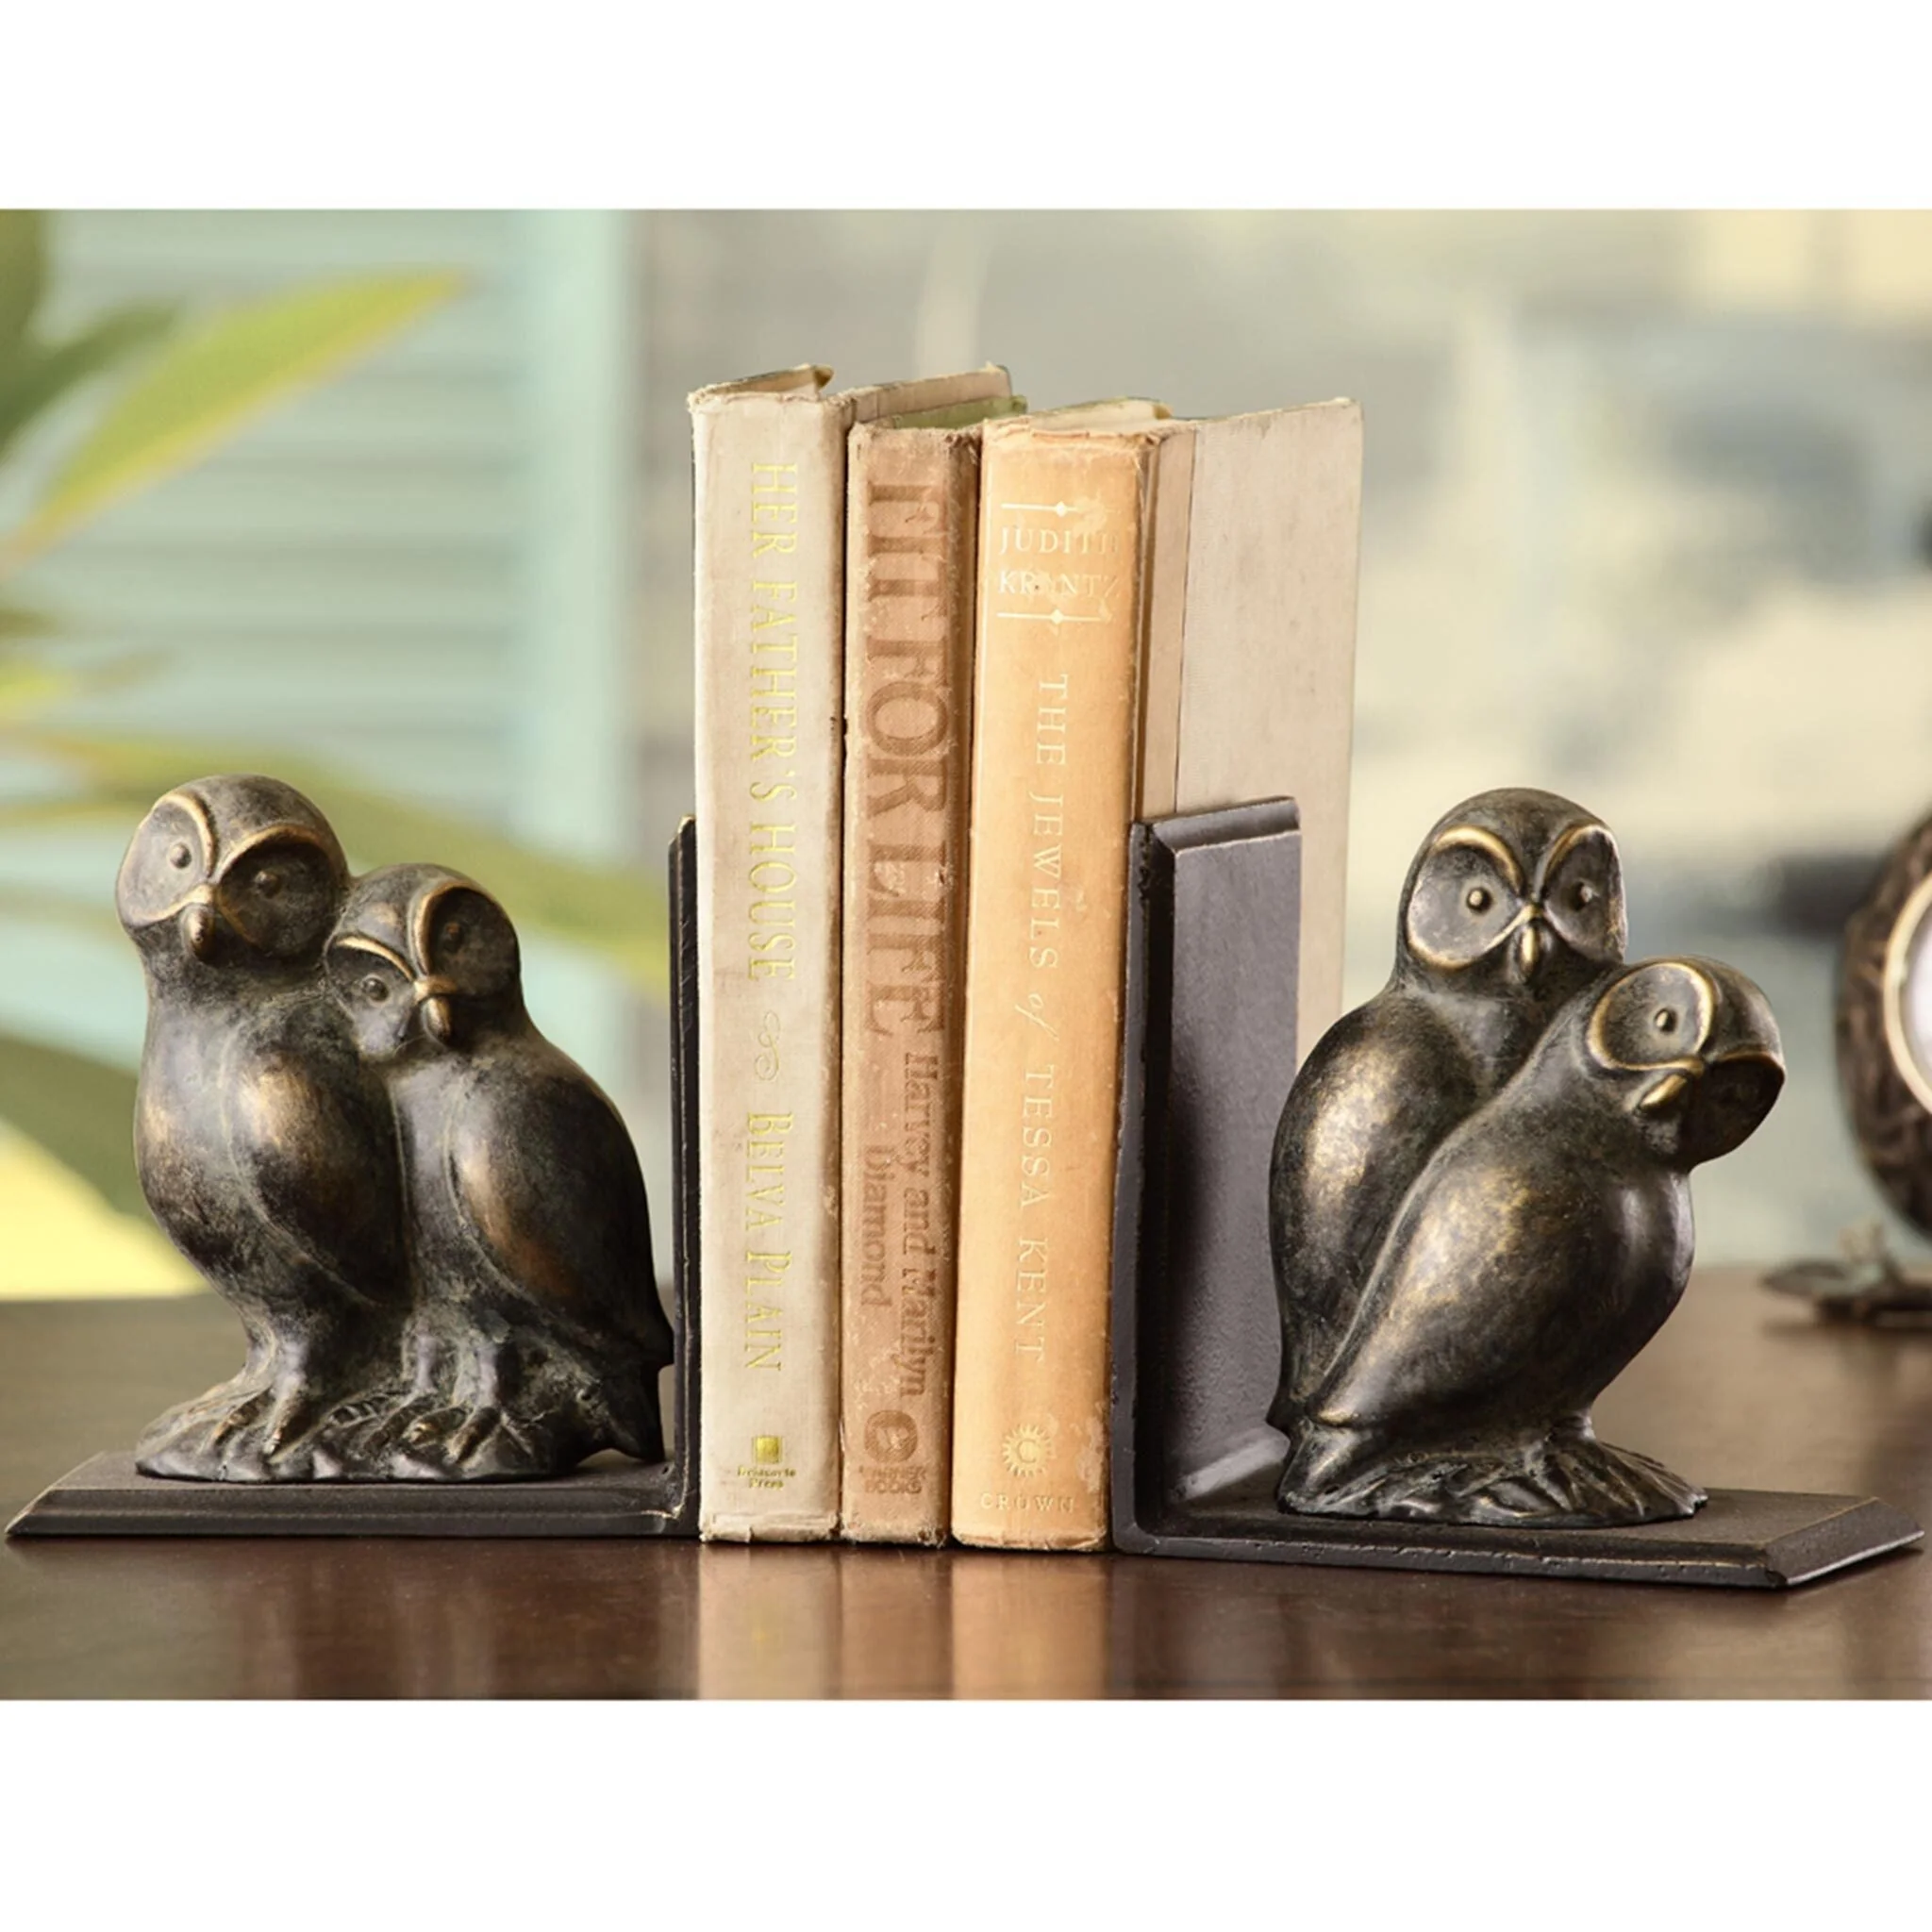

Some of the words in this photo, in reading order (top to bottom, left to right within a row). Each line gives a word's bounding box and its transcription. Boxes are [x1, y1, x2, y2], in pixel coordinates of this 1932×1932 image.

[750, 462, 798, 559] HER
[865, 480, 948, 615] FIT
[748, 579, 798, 802] FATHER'S
[865, 635, 949, 819] FOR
[1036, 673, 1069, 765] THE
[747, 822, 797, 982] HOUSE
[864, 839, 947, 1037] LIFE
[1028, 791, 1064, 970] JEWELS
[1014, 991, 1060, 1042] of
[744, 1111, 794, 1232] BELVA
[894, 1052, 938, 1178] Harvey
[1021, 1063, 1056, 1209] TESSA
[859, 1144, 895, 1308] Diamond
[902, 1187, 937, 1257] and
[743, 1250, 793, 1373] PLAIN
[890, 1267, 938, 1397] Marilyn
[1015, 1236, 1049, 1362] KENT
[979, 1491, 1075, 1513] CROWN
